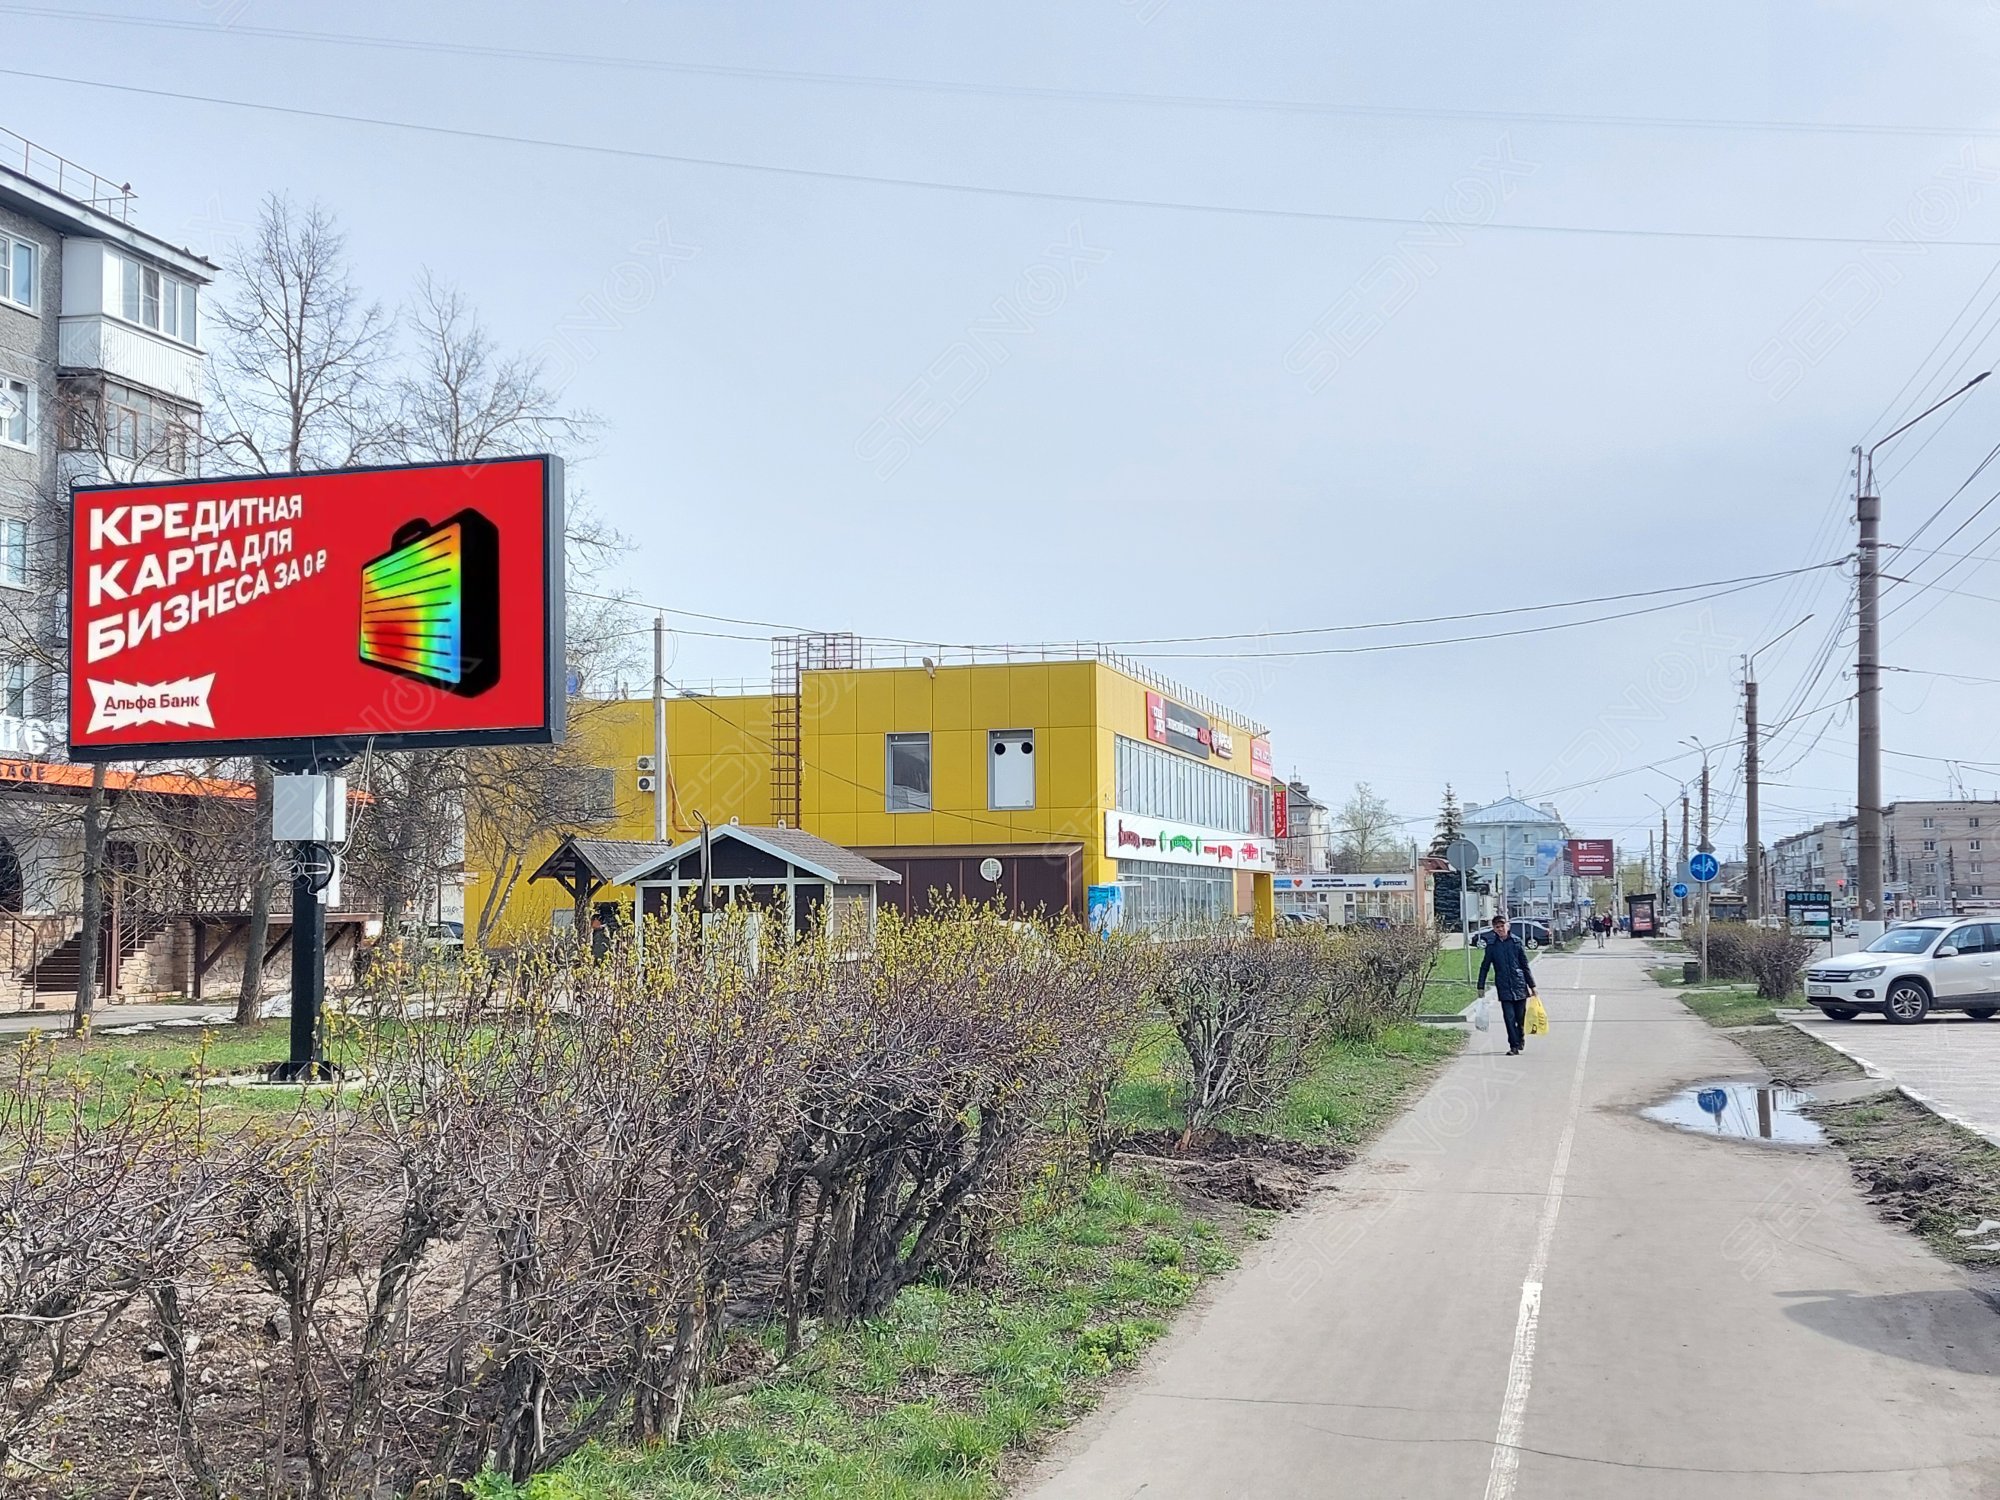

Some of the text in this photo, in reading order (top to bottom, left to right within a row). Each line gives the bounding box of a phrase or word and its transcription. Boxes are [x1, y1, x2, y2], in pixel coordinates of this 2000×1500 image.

[90, 494, 302, 551] КРЕДИТНАЯ
[88, 527, 292, 607] КАРТА ДЛЯ
[87, 569, 270, 664] БИЗНЕСА
[273, 558, 301, 590] ЗА
[303, 557, 313, 578] 0
[103, 694, 200, 717] Альфа Банк
[0, 763, 46, 781] АФЕ
[1787, 892, 1830, 901] ФУТБОЛ
